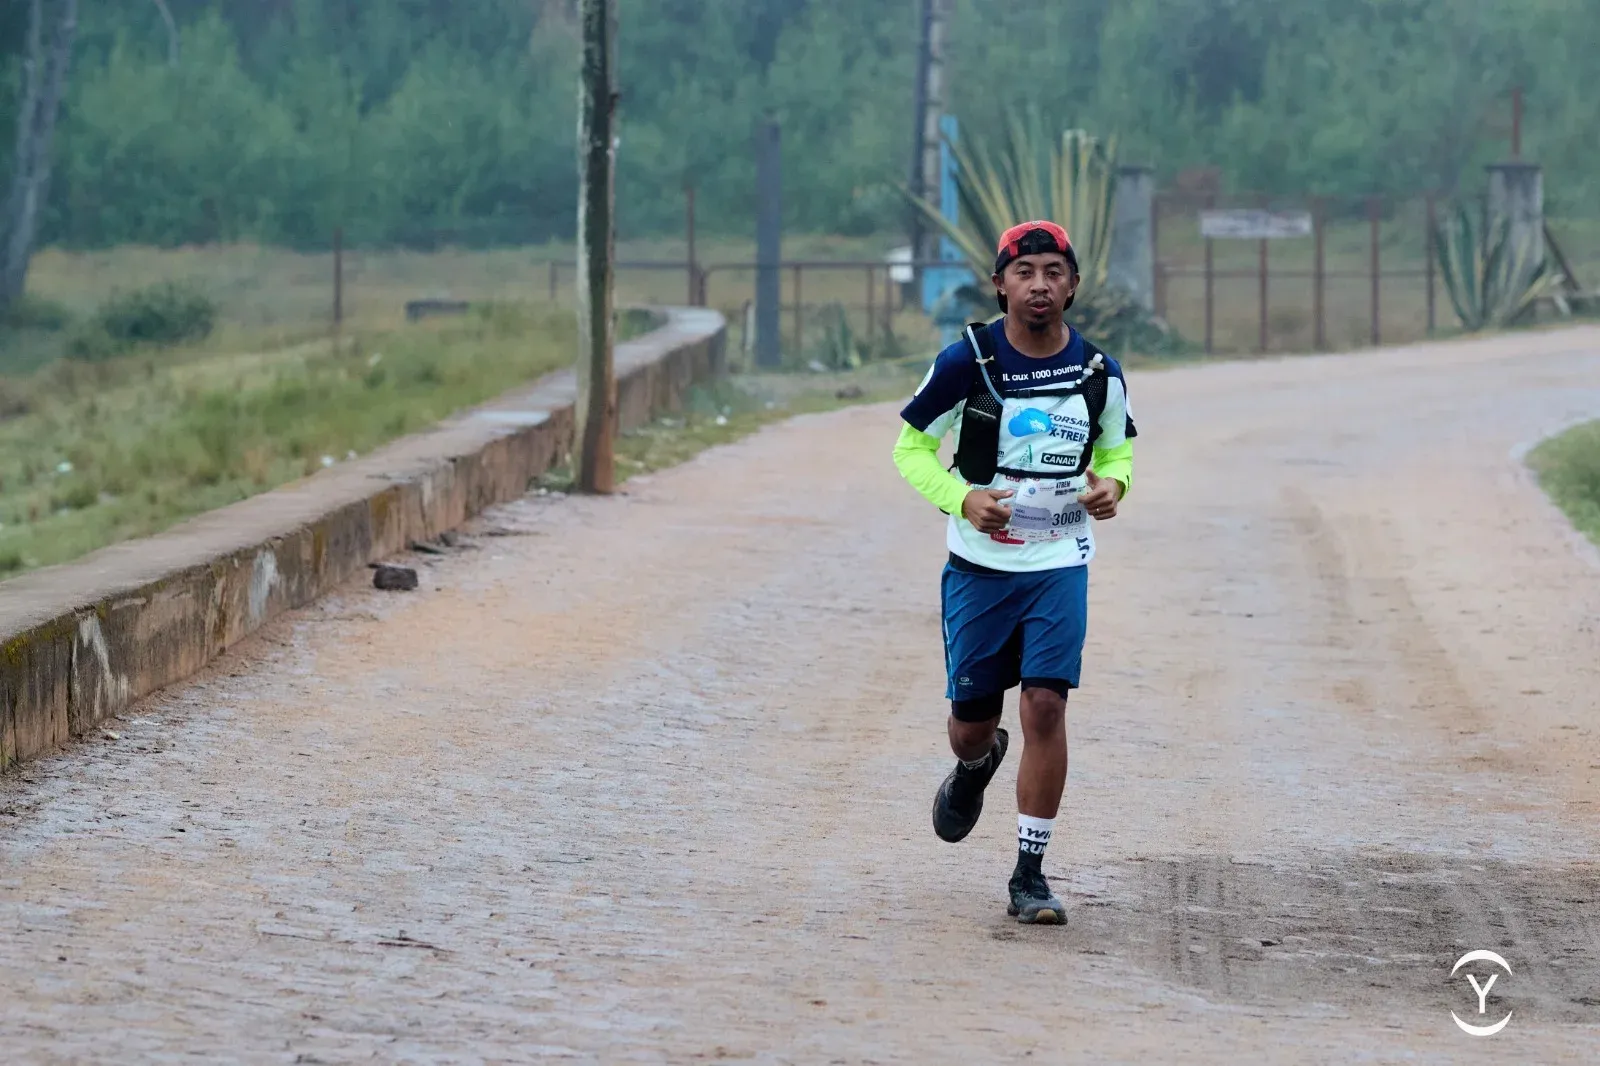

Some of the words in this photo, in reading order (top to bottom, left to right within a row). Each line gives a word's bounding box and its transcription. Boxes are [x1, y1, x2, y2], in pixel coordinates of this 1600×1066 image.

[1002, 373, 1010, 382] IL
[1012, 373, 1028, 381] aux
[1031, 369, 1051, 380] 1000
[1053, 364, 1082, 376] sourires
[1043, 454, 1076, 465] CANAL+
[1052, 510, 1082, 526] 3008
